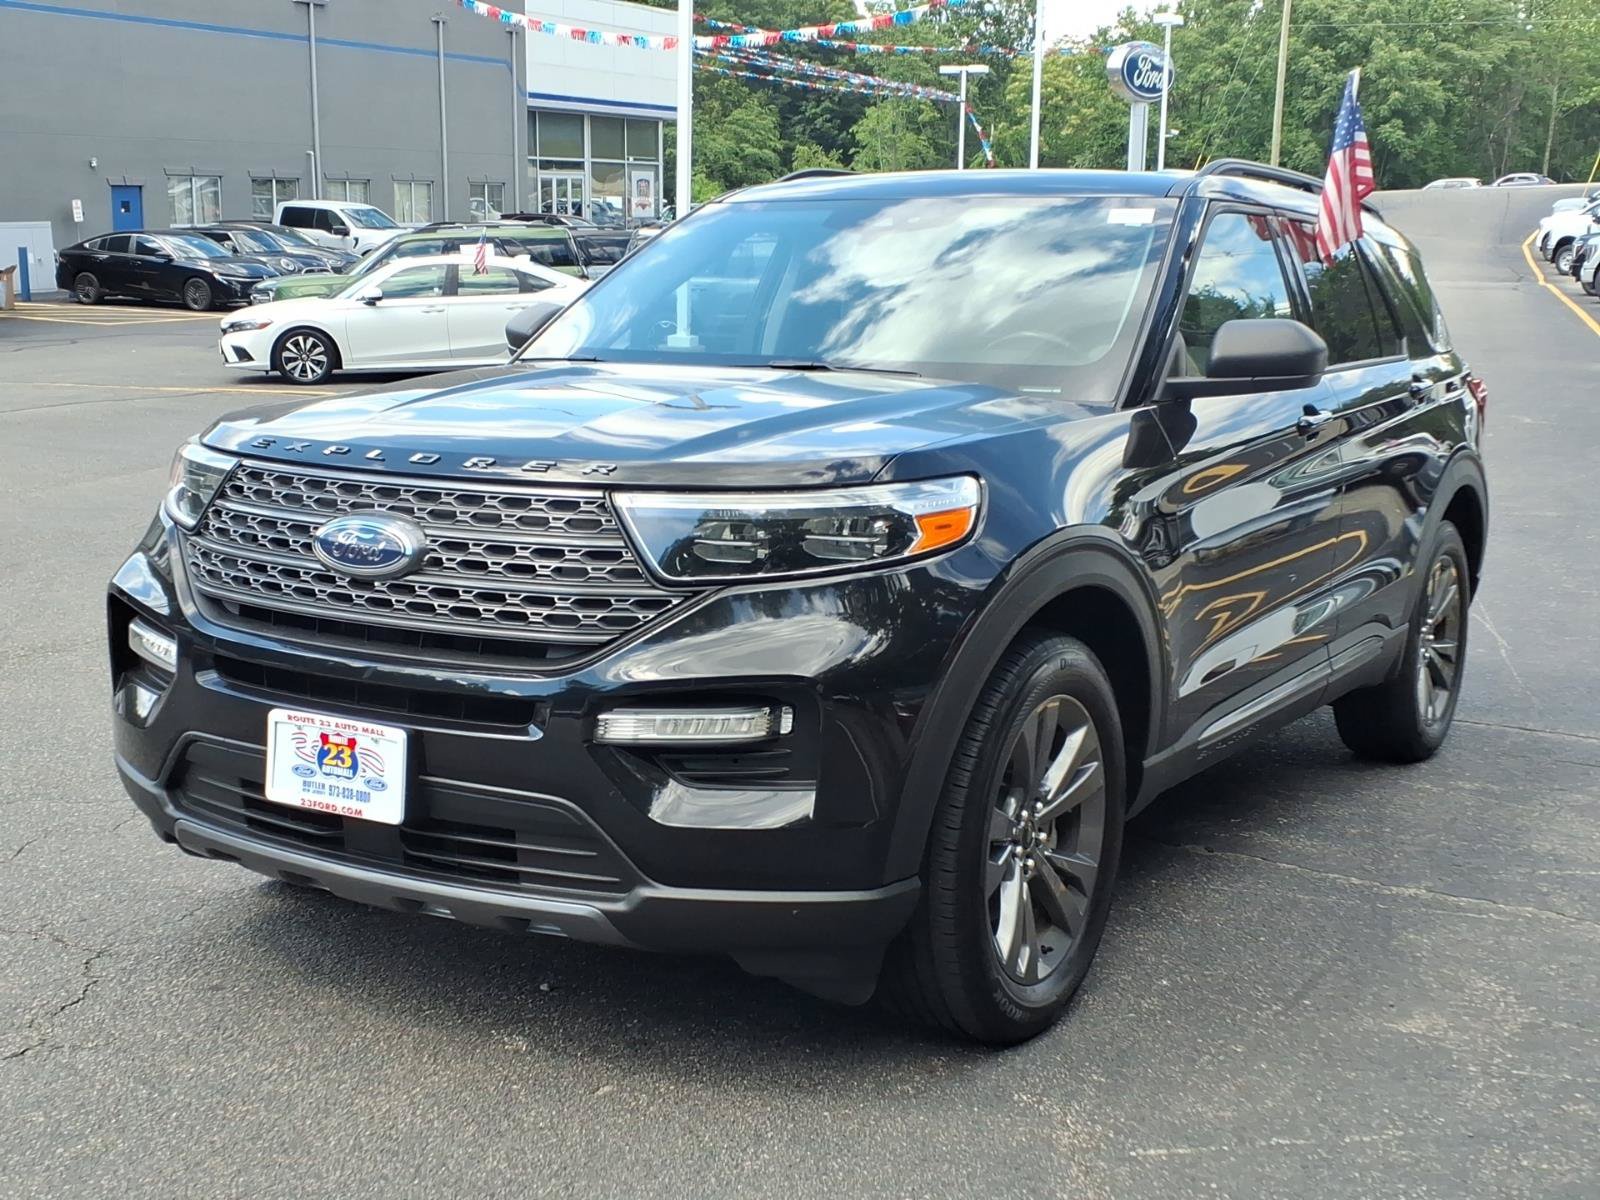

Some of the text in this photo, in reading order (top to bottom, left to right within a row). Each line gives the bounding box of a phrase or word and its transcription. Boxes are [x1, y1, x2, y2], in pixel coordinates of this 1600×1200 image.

[250, 437, 618, 476] EXPLORER
[332, 529, 387, 562] Ford
[287, 714, 386, 737] ROUTE 23 AUTO MALL
[322, 743, 353, 768] 23
[302, 779, 326, 790] BUTLER
[300, 798, 363, 816] 23FORD.COM
